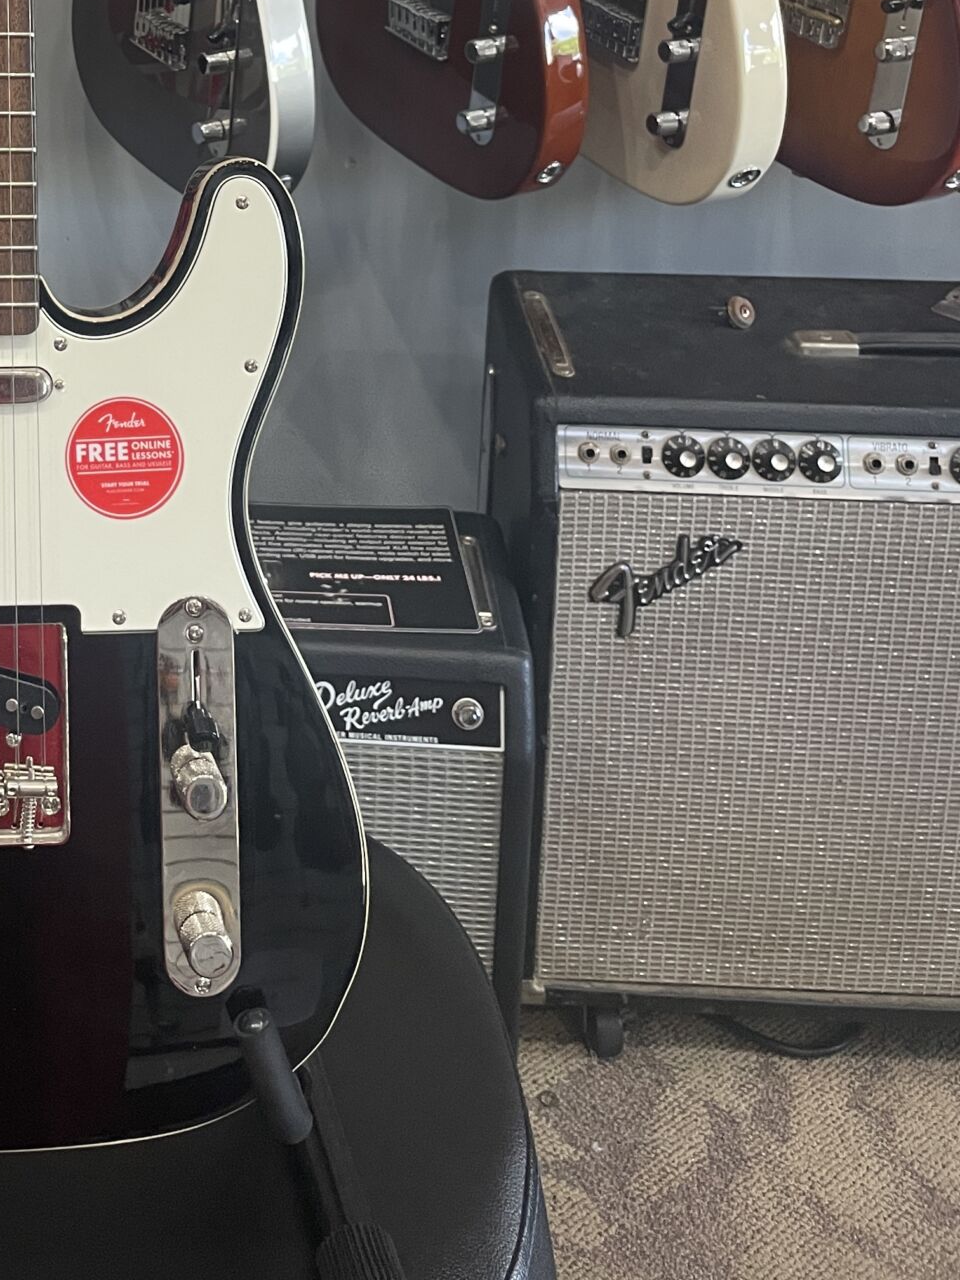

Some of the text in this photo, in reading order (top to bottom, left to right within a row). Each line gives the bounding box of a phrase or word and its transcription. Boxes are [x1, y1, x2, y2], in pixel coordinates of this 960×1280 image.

[98, 412, 145, 432] Fender
[75, 439, 172, 464] FREE ONLINE
[872, 441, 908, 453] VIBRATO
[76, 463, 89, 471] FOR
[309, 571, 332, 579] PICK
[589, 533, 744, 639] Fender
[314, 680, 393, 711] Deluxe
[348, 731, 383, 740] MUSICAL
[383, 734, 439, 744] INSTRUMENTS
